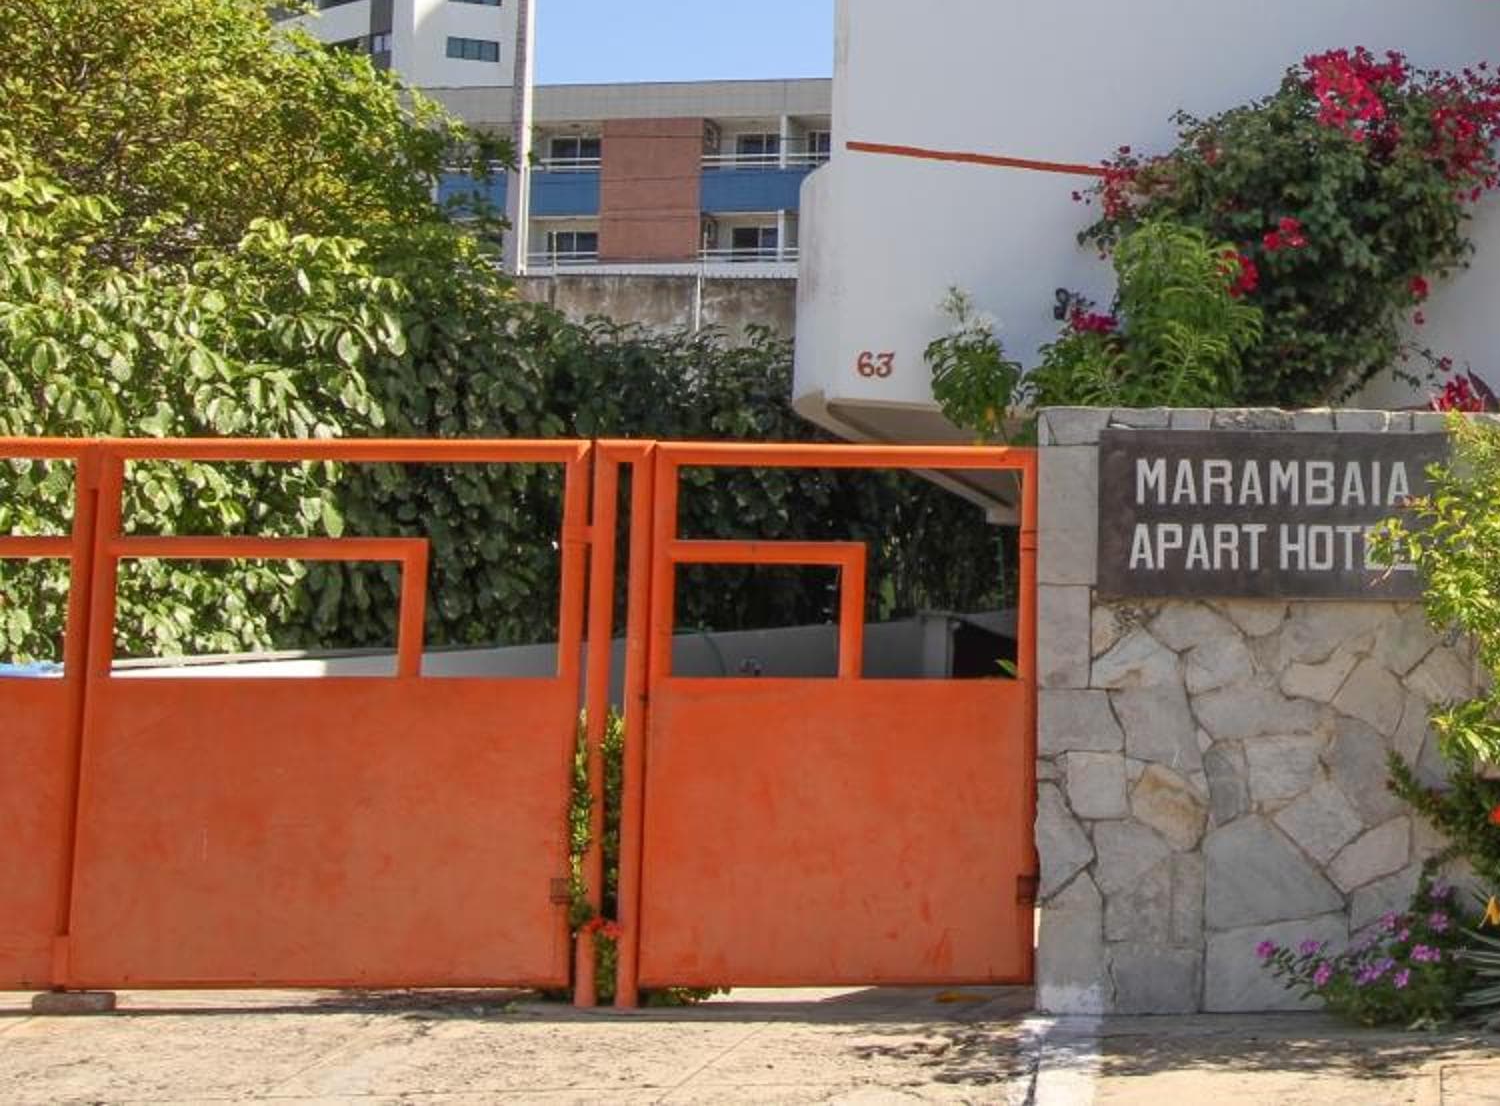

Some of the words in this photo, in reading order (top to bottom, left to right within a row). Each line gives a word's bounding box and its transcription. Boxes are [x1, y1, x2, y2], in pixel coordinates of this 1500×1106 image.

[857, 350, 895, 379] 63
[1135, 457, 1410, 506] MARAMBAIA
[1128, 522, 1267, 571] APART
